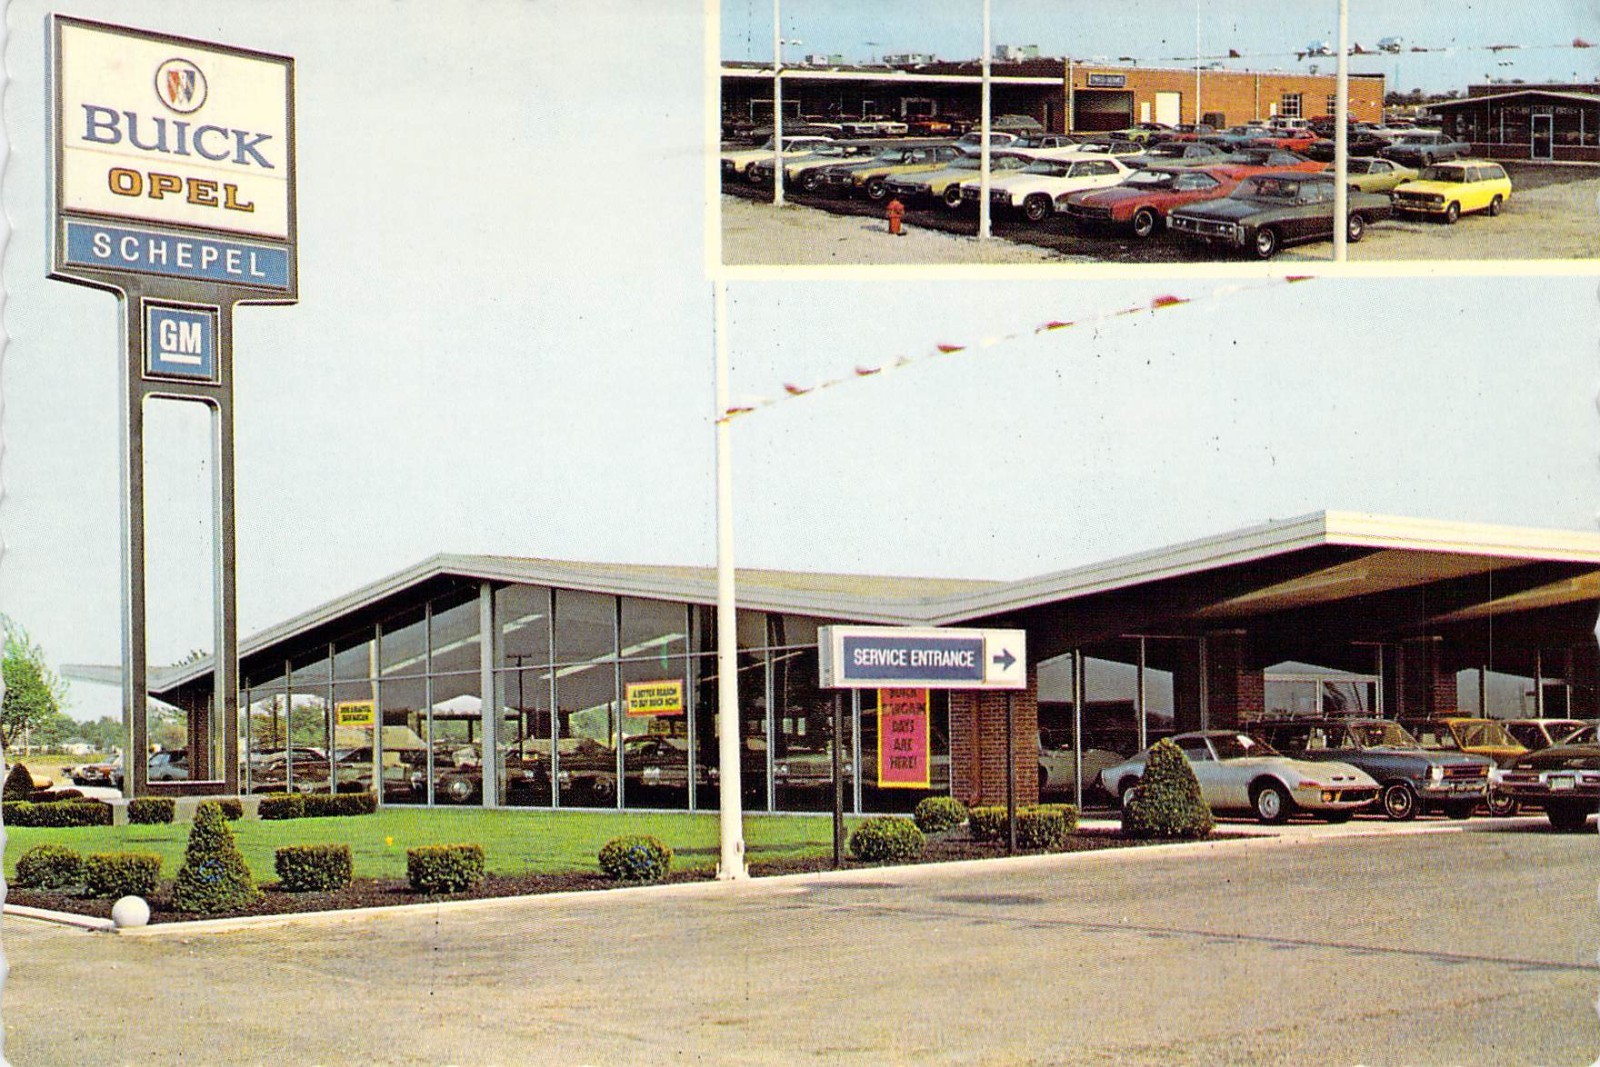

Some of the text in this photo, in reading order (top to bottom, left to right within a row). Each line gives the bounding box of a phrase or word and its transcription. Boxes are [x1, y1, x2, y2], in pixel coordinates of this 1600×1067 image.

[81, 103, 275, 169] BUICK
[108, 167, 255, 213] OPEL
[92, 232, 266, 278] SCHEPEL
[159, 319, 201, 352] GM
[853, 648, 975, 668] SERVICE ENTRANCE
[892, 719, 914, 733] DAYS
[894, 738, 913, 751] ARE
